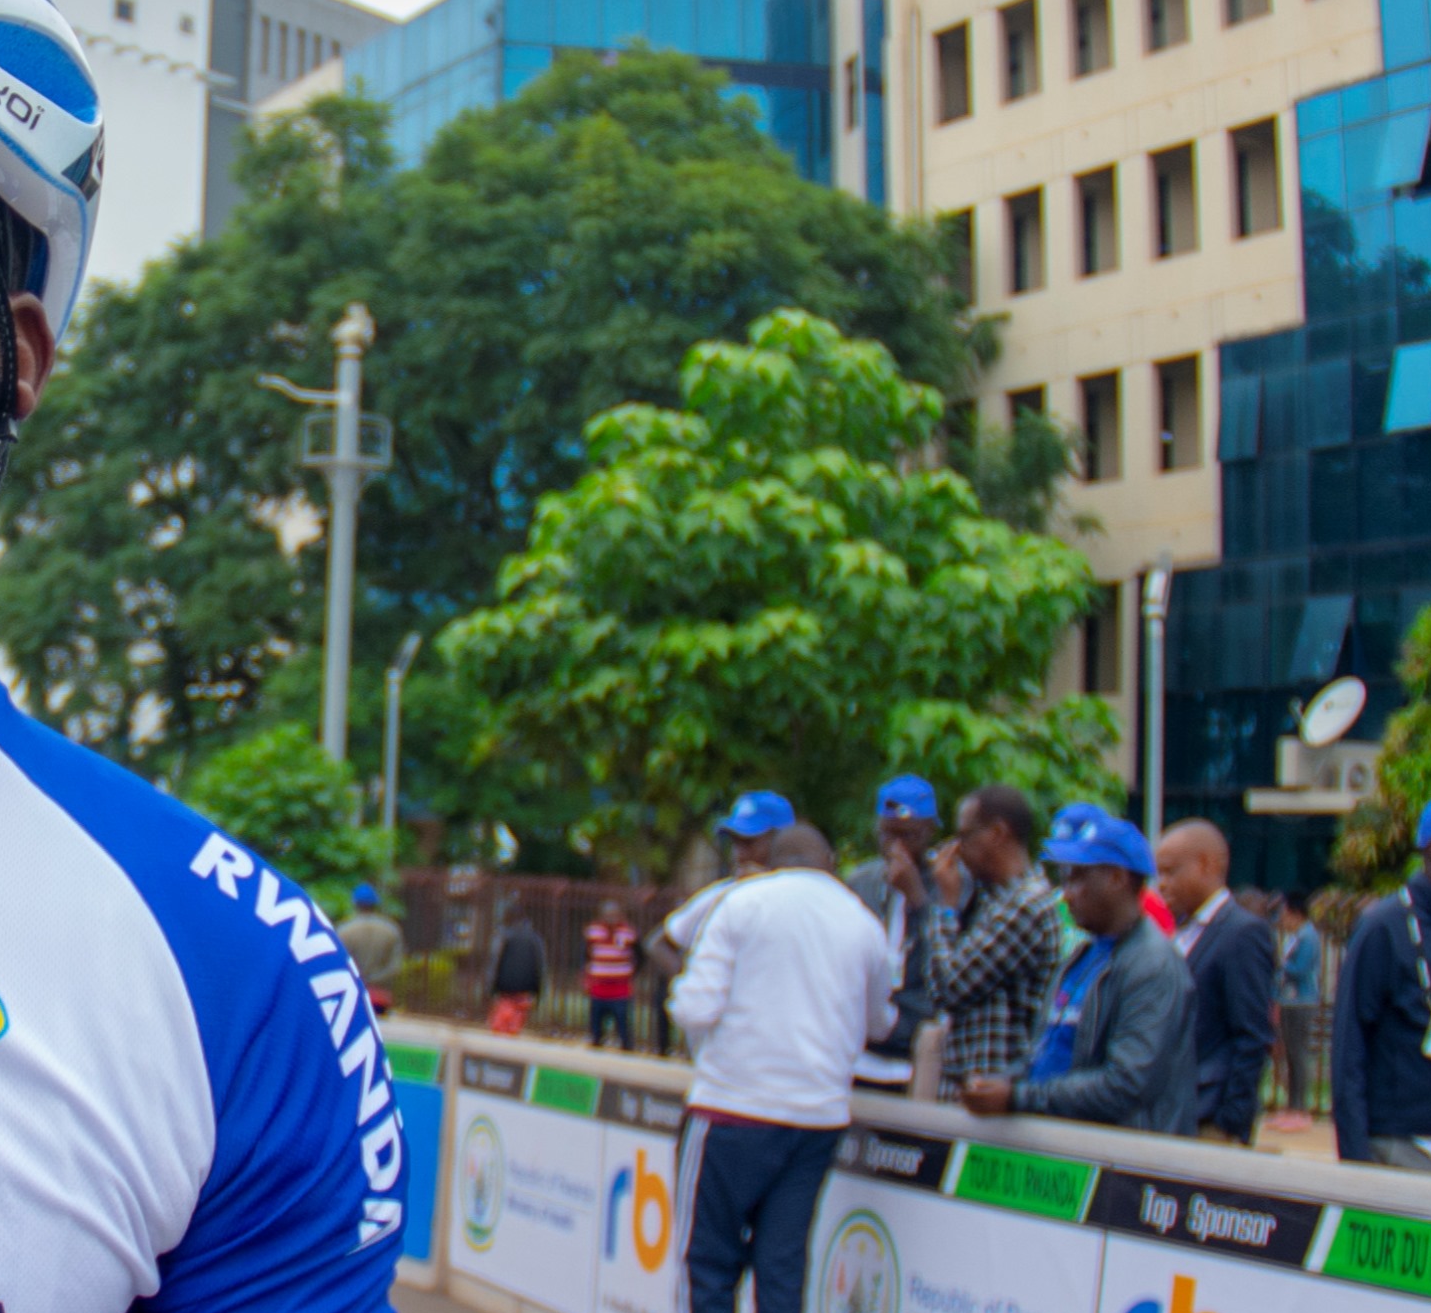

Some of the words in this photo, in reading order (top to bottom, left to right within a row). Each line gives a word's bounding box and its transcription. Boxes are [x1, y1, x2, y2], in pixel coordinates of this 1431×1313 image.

[190, 830, 403, 1257] RWANDA
[864, 1135, 927, 1177] Sponsor
[1142, 1186, 1179, 1235] Top
[1186, 1192, 1277, 1249] Sponsor
[1348, 1220, 1394, 1274] TOUR
[1400, 1229, 1429, 1281] DU
